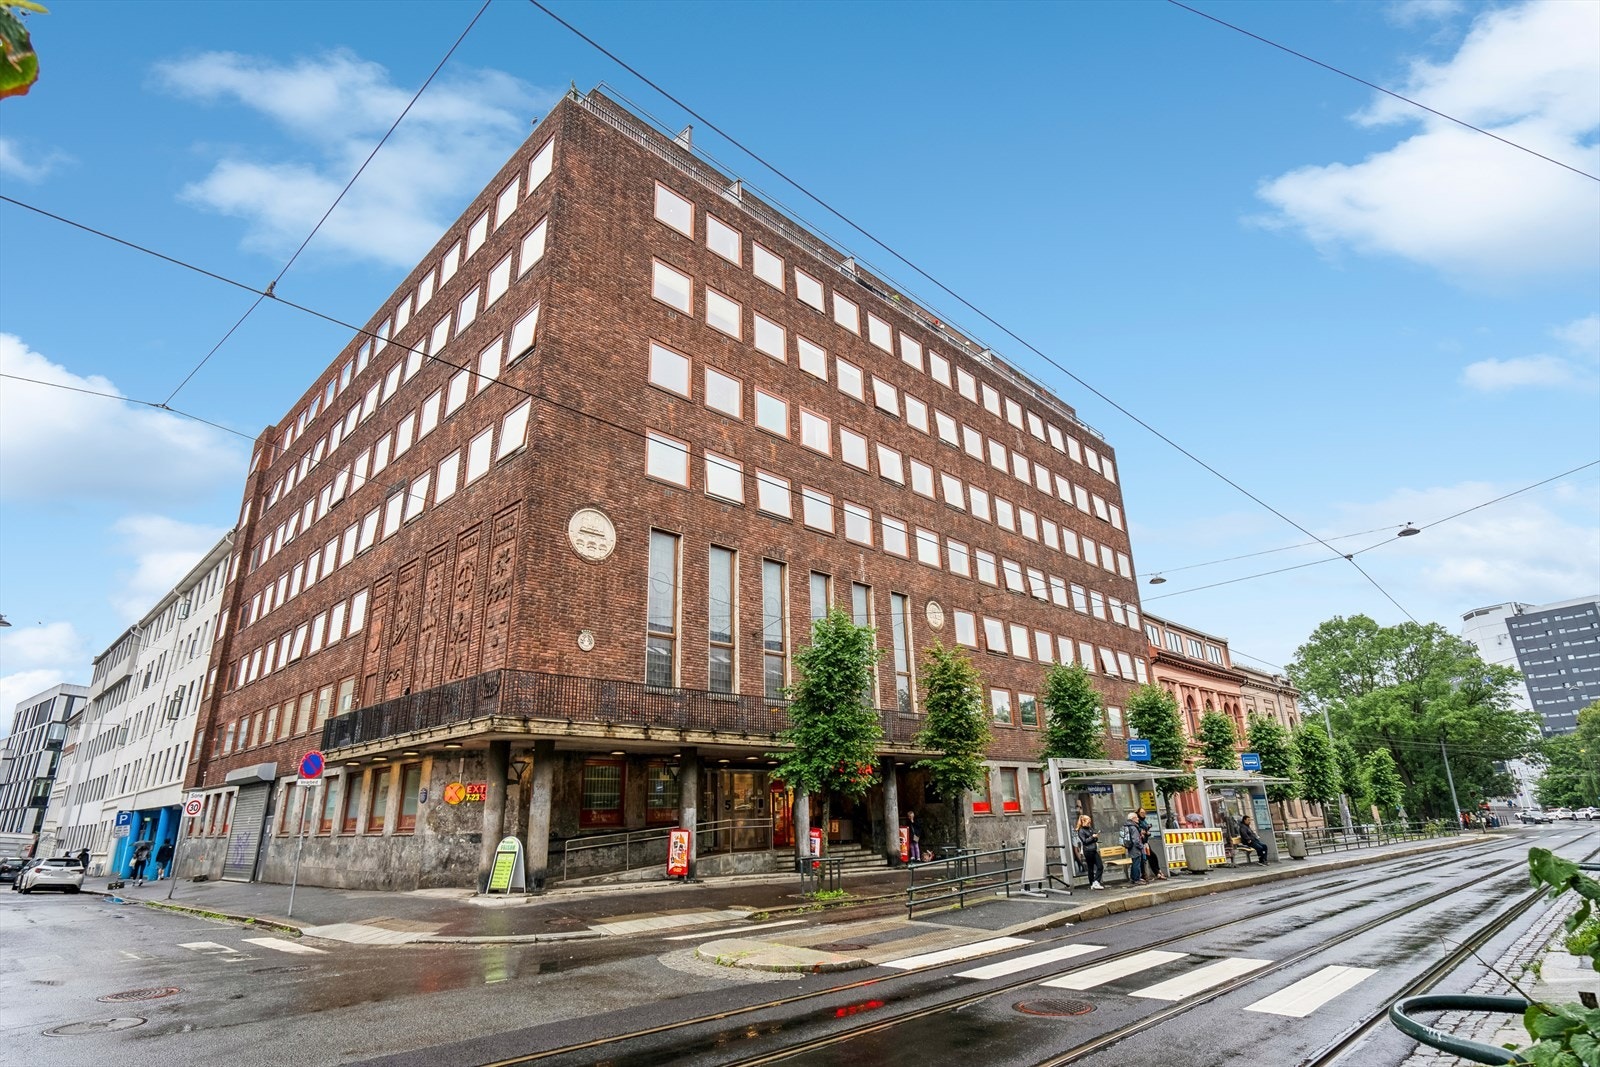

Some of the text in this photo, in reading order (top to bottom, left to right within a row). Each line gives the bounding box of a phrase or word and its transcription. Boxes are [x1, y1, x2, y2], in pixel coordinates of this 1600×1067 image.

[467, 785, 486, 793] EXT
[725, 800, 731, 810] 5
[119, 815, 128, 825] P
